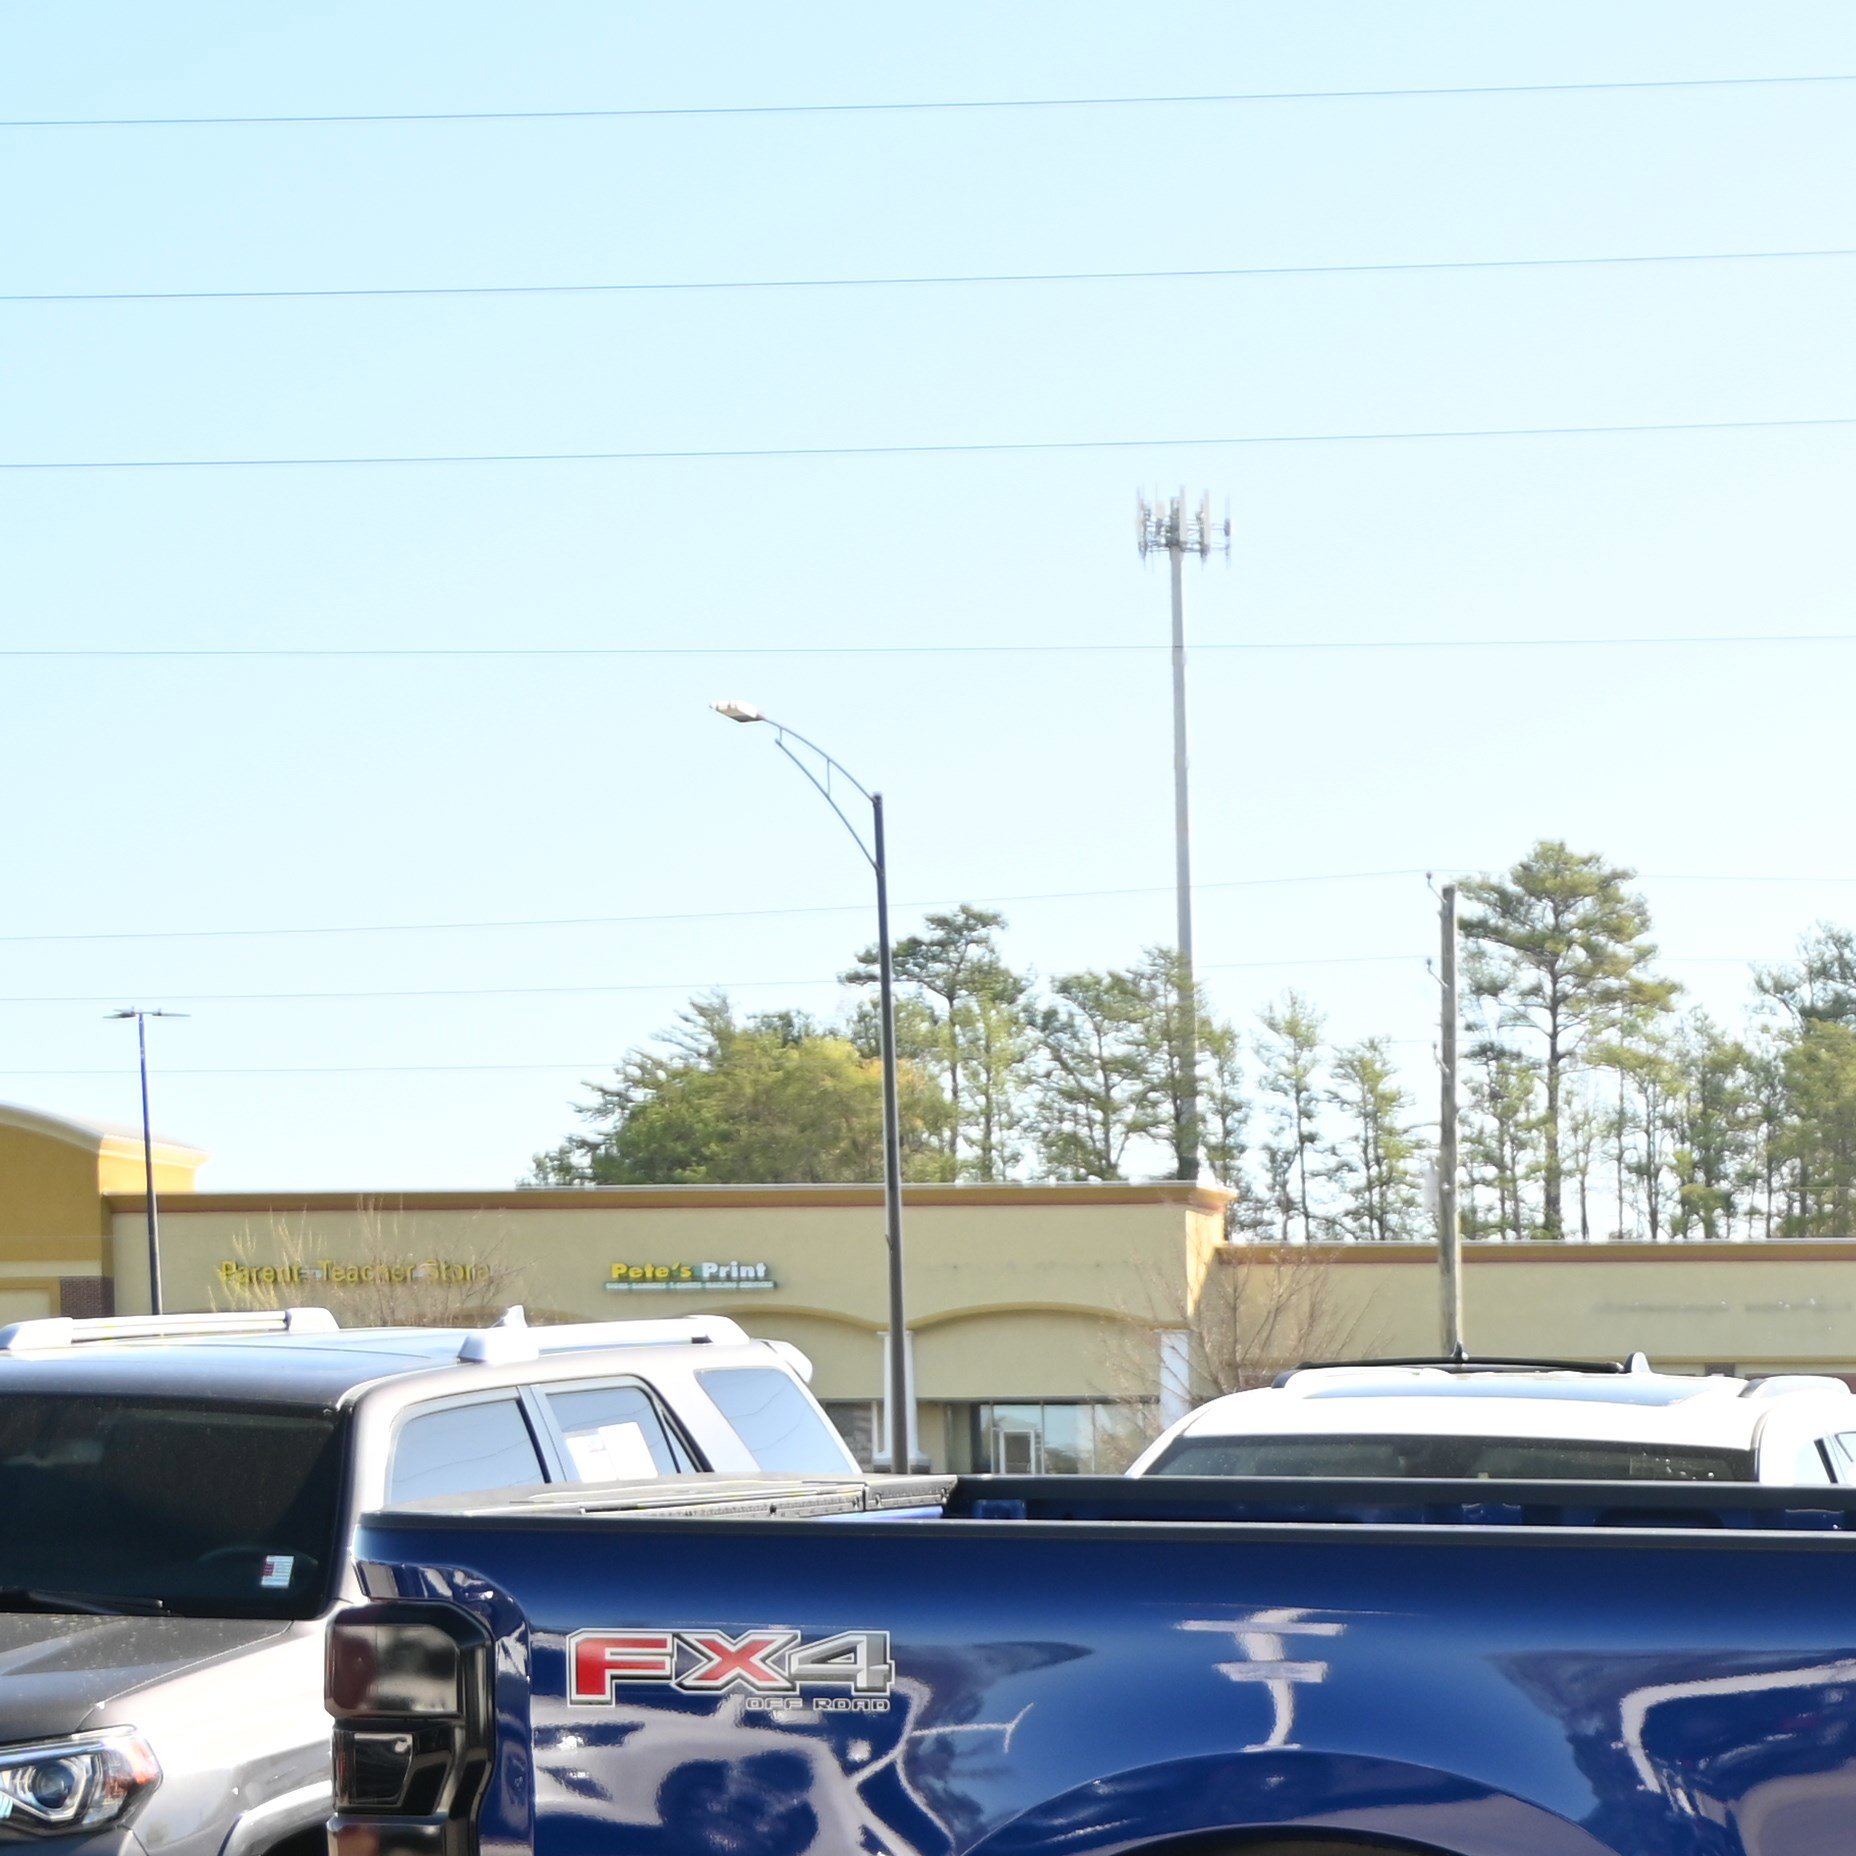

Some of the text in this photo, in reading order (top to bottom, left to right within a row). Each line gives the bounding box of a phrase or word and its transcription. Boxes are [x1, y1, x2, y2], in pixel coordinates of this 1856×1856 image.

[220, 1259, 301, 1284] Parent
[318, 1258, 416, 1284] Teacher
[611, 1260, 768, 1279] Pete's Print
[566, 1628, 895, 1708] FX4
[745, 1697, 892, 1712] OFF ROAD
